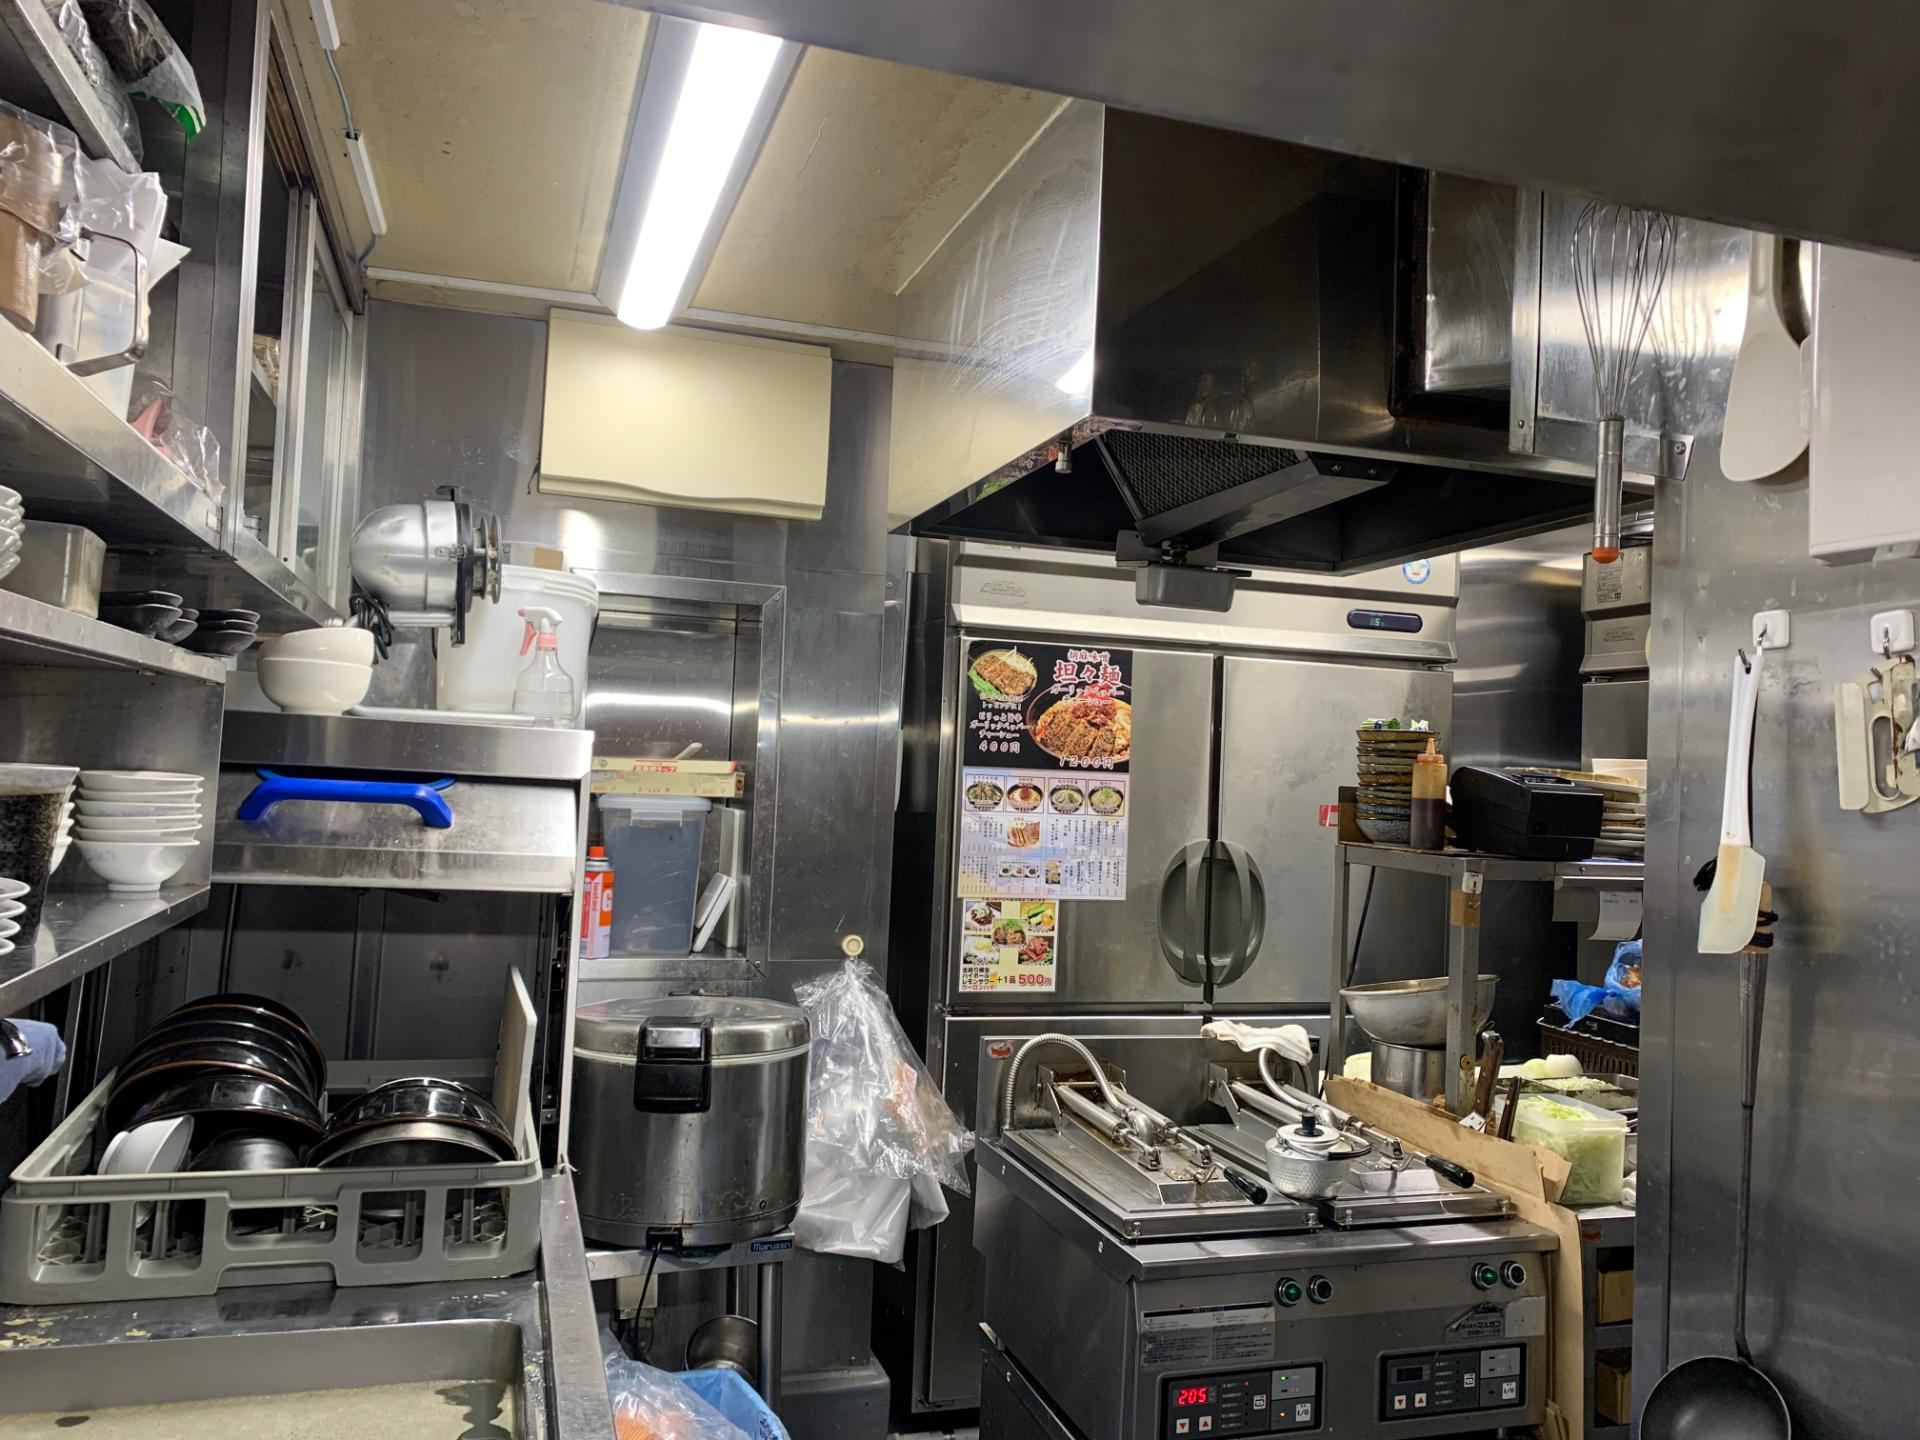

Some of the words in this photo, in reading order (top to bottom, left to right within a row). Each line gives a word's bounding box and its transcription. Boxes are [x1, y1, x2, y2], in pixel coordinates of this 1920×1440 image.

[1068, 649, 1111, 663] 胡麻味噌
[1050, 684, 1124, 696] ガーリックペッパー
[1062, 695, 1112, 706] チャーシュー
[978, 741, 1021, 754] 400円
[1059, 755, 1115, 770] 1200円
[1018, 974, 1052, 986] 500円
[1177, 1388, 1207, 1405] 205
